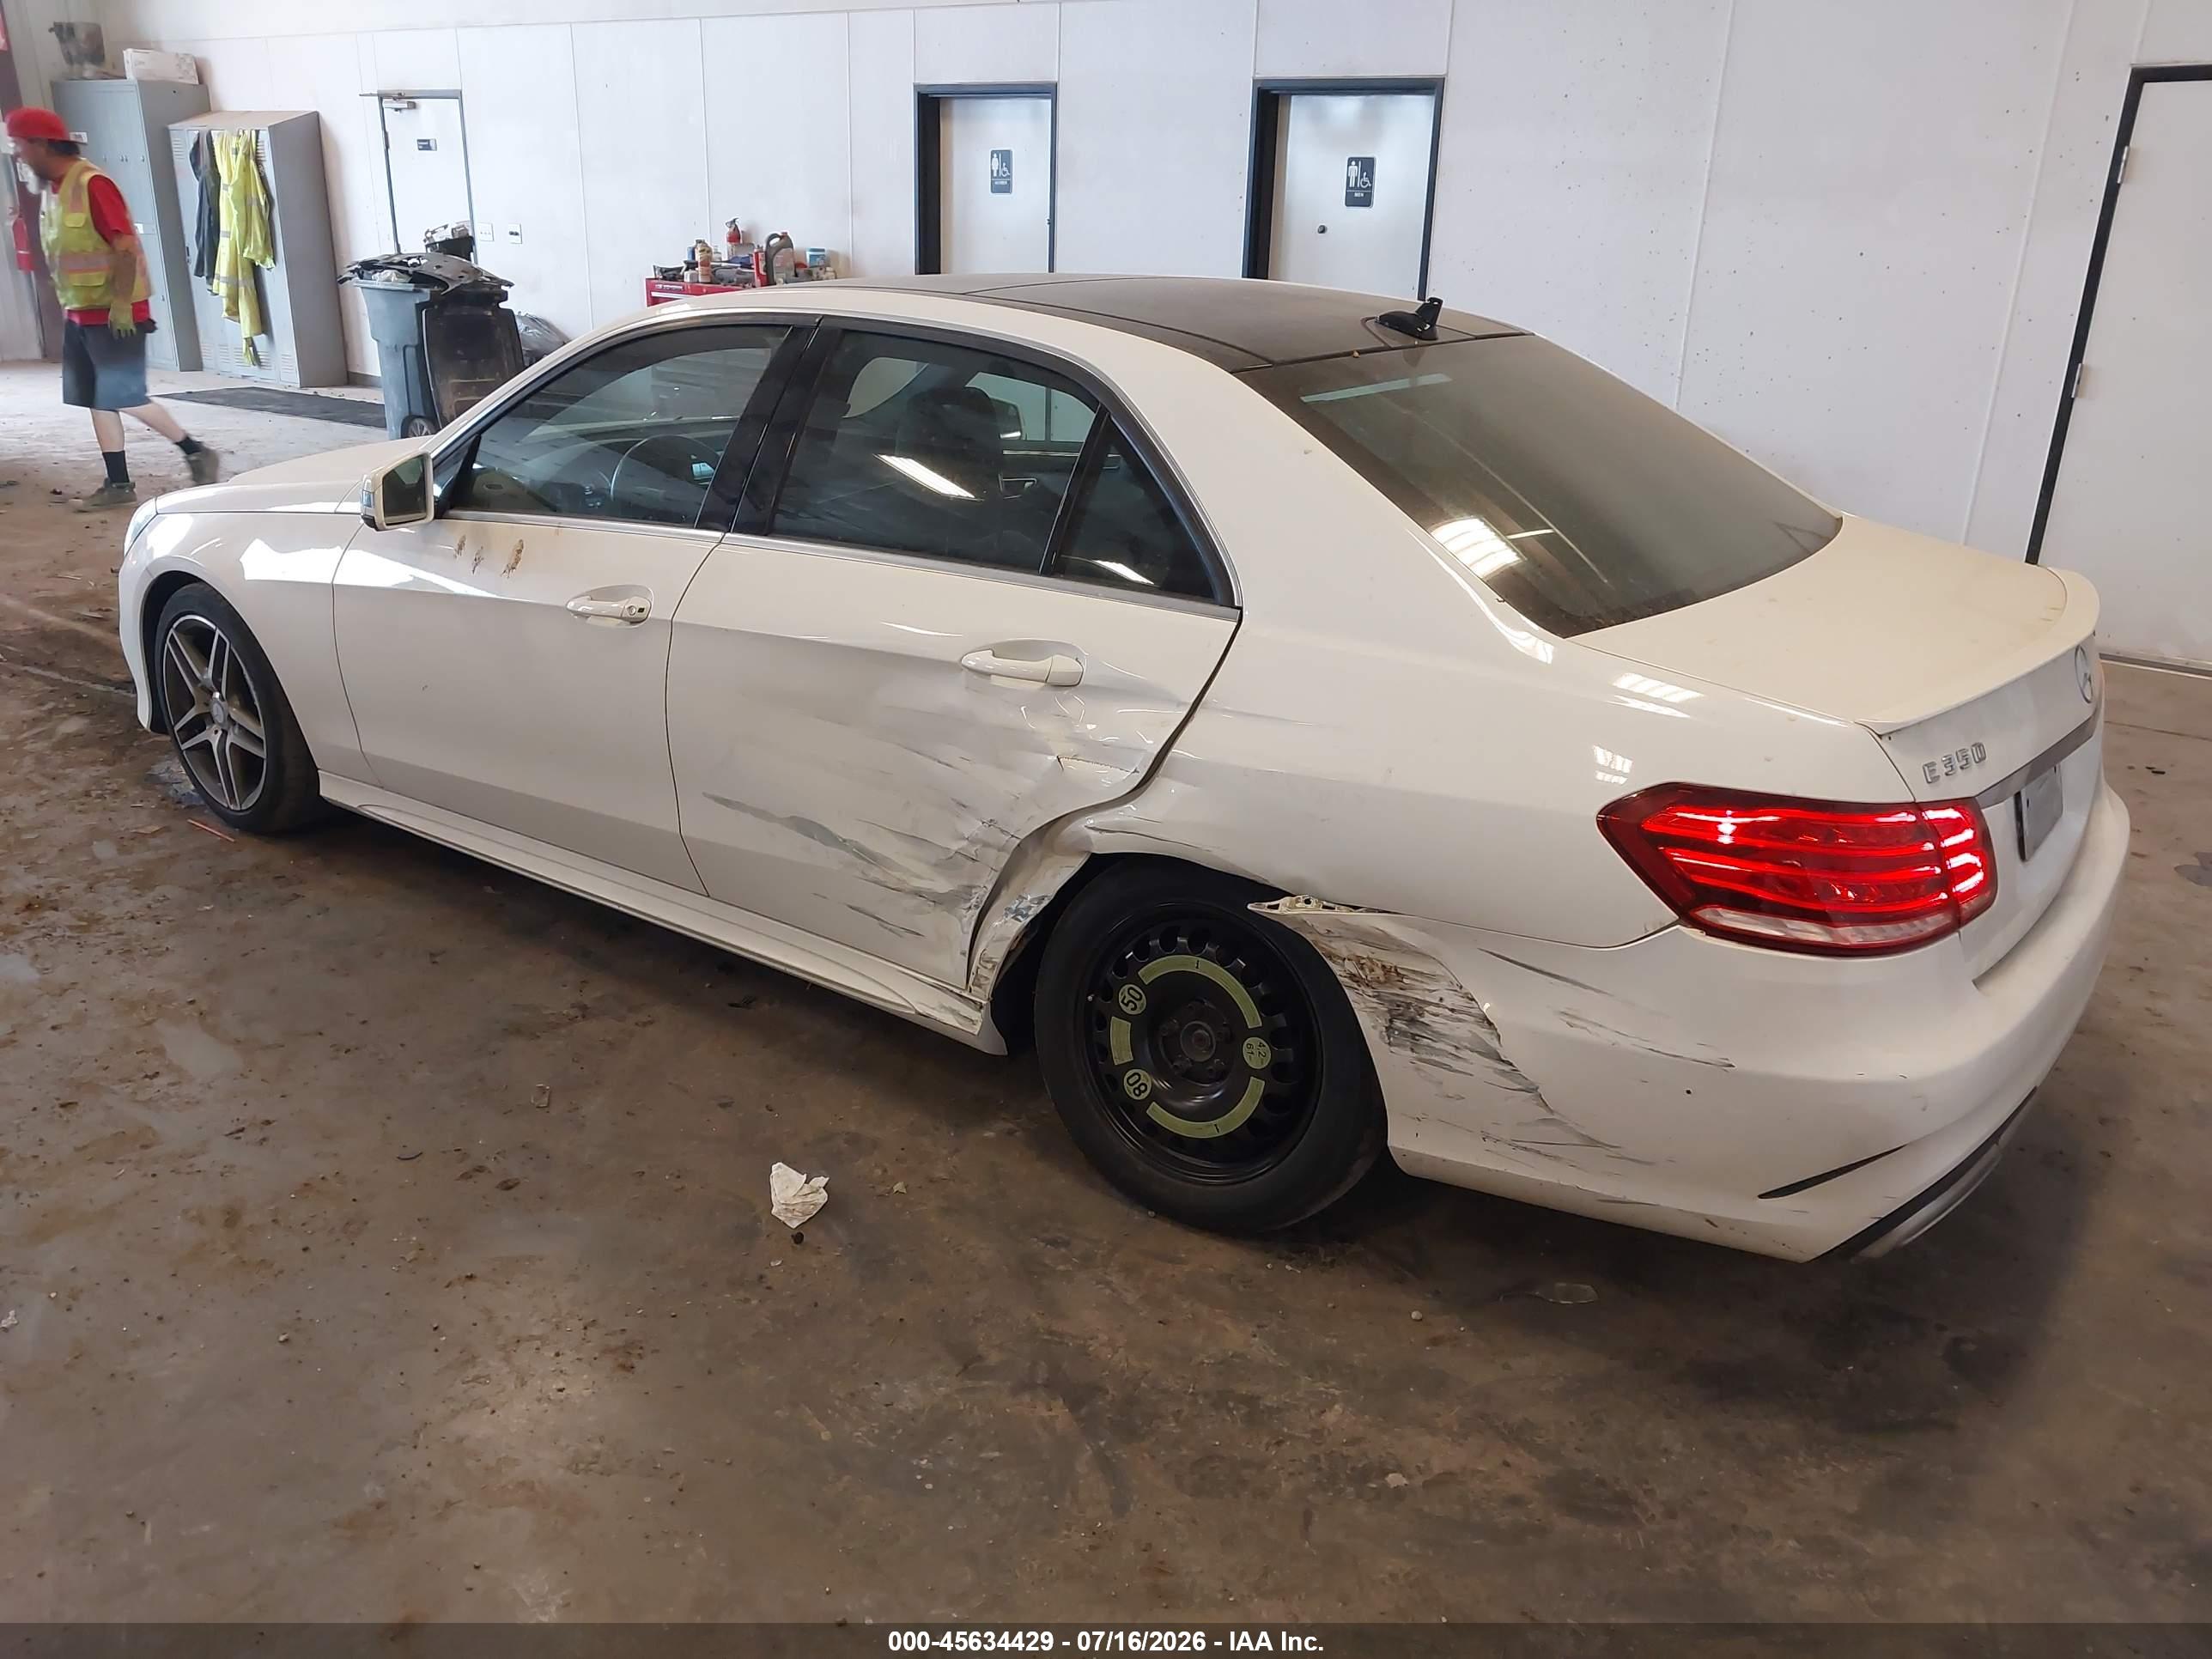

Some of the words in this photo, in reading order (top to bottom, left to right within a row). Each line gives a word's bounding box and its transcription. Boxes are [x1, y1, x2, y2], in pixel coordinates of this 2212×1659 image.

[1923, 761, 1941, 784] E
[1942, 742, 1987, 777] 350
[1121, 986, 1143, 1012] 50
[1126, 1072, 1148, 1097] 80
